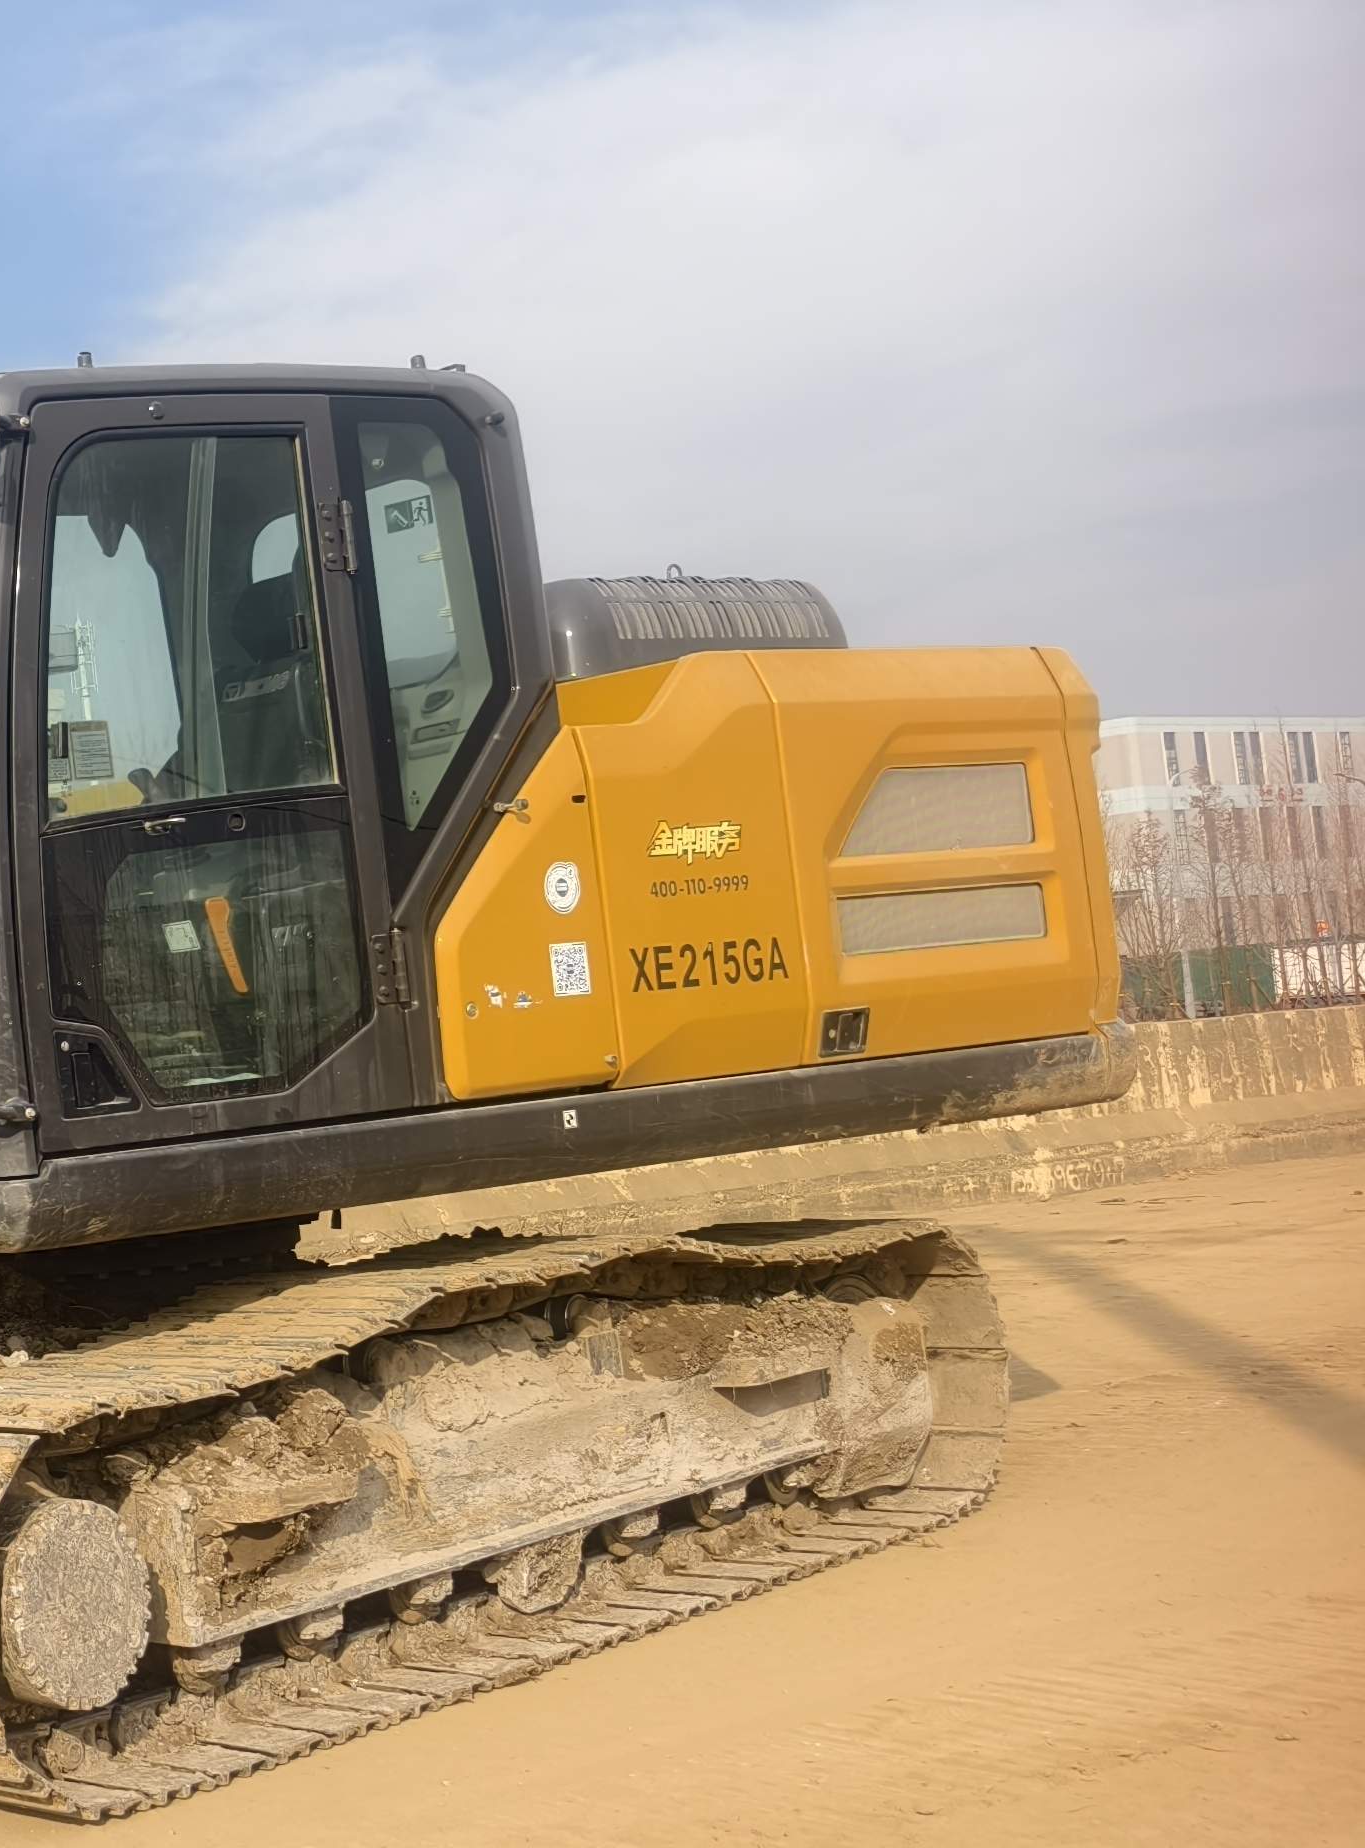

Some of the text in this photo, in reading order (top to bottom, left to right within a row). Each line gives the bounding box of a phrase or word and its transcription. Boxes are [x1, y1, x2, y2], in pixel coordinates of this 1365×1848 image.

[647, 820, 742, 865] 金牌服务
[650, 874, 750, 898] 400-110-9999
[629, 936, 790, 993] XE215GA
